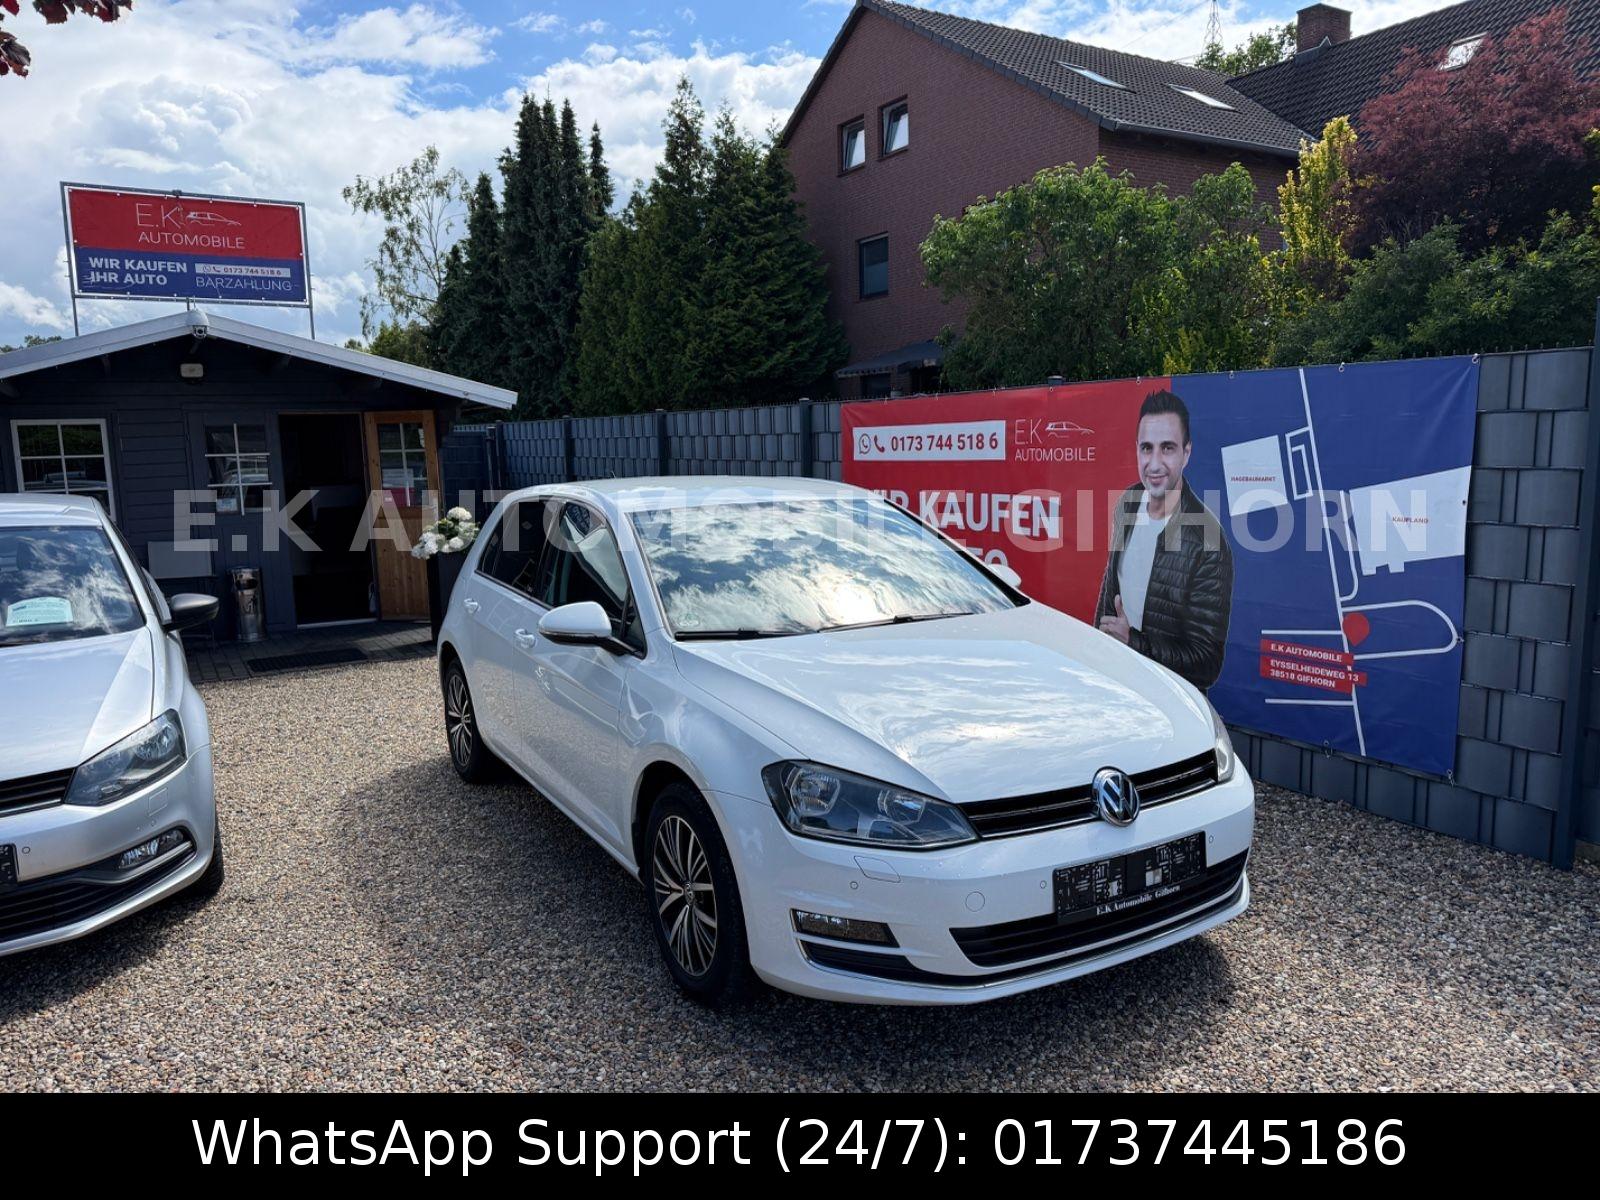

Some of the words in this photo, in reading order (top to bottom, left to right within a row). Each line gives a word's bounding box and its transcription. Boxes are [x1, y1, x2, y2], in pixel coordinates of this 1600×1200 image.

[135, 202, 182, 229] E.K
[138, 231, 246, 250] AUTOMOBILE
[88, 256, 120, 271] WIR
[124, 258, 187, 274] KAUFEN
[89, 271, 119, 284] IHR
[123, 272, 168, 286] AUTO
[195, 276, 293, 291] BARZAHLUNG
[1014, 418, 1043, 446] E.K
[891, 435, 923, 452] 0173
[926, 434, 953, 451] 744
[957, 432, 985, 451] 518
[1014, 447, 1096, 462] AUTOMOBILE
[919, 490, 1060, 539] KAUFEN
[1285, 646, 1342, 663] AUTOMOBILE
[1270, 659, 1345, 679] EYSSELHEIDEWEG
[1347, 673, 1359, 682] 13
[1296, 674, 1336, 688] GIFHORN
